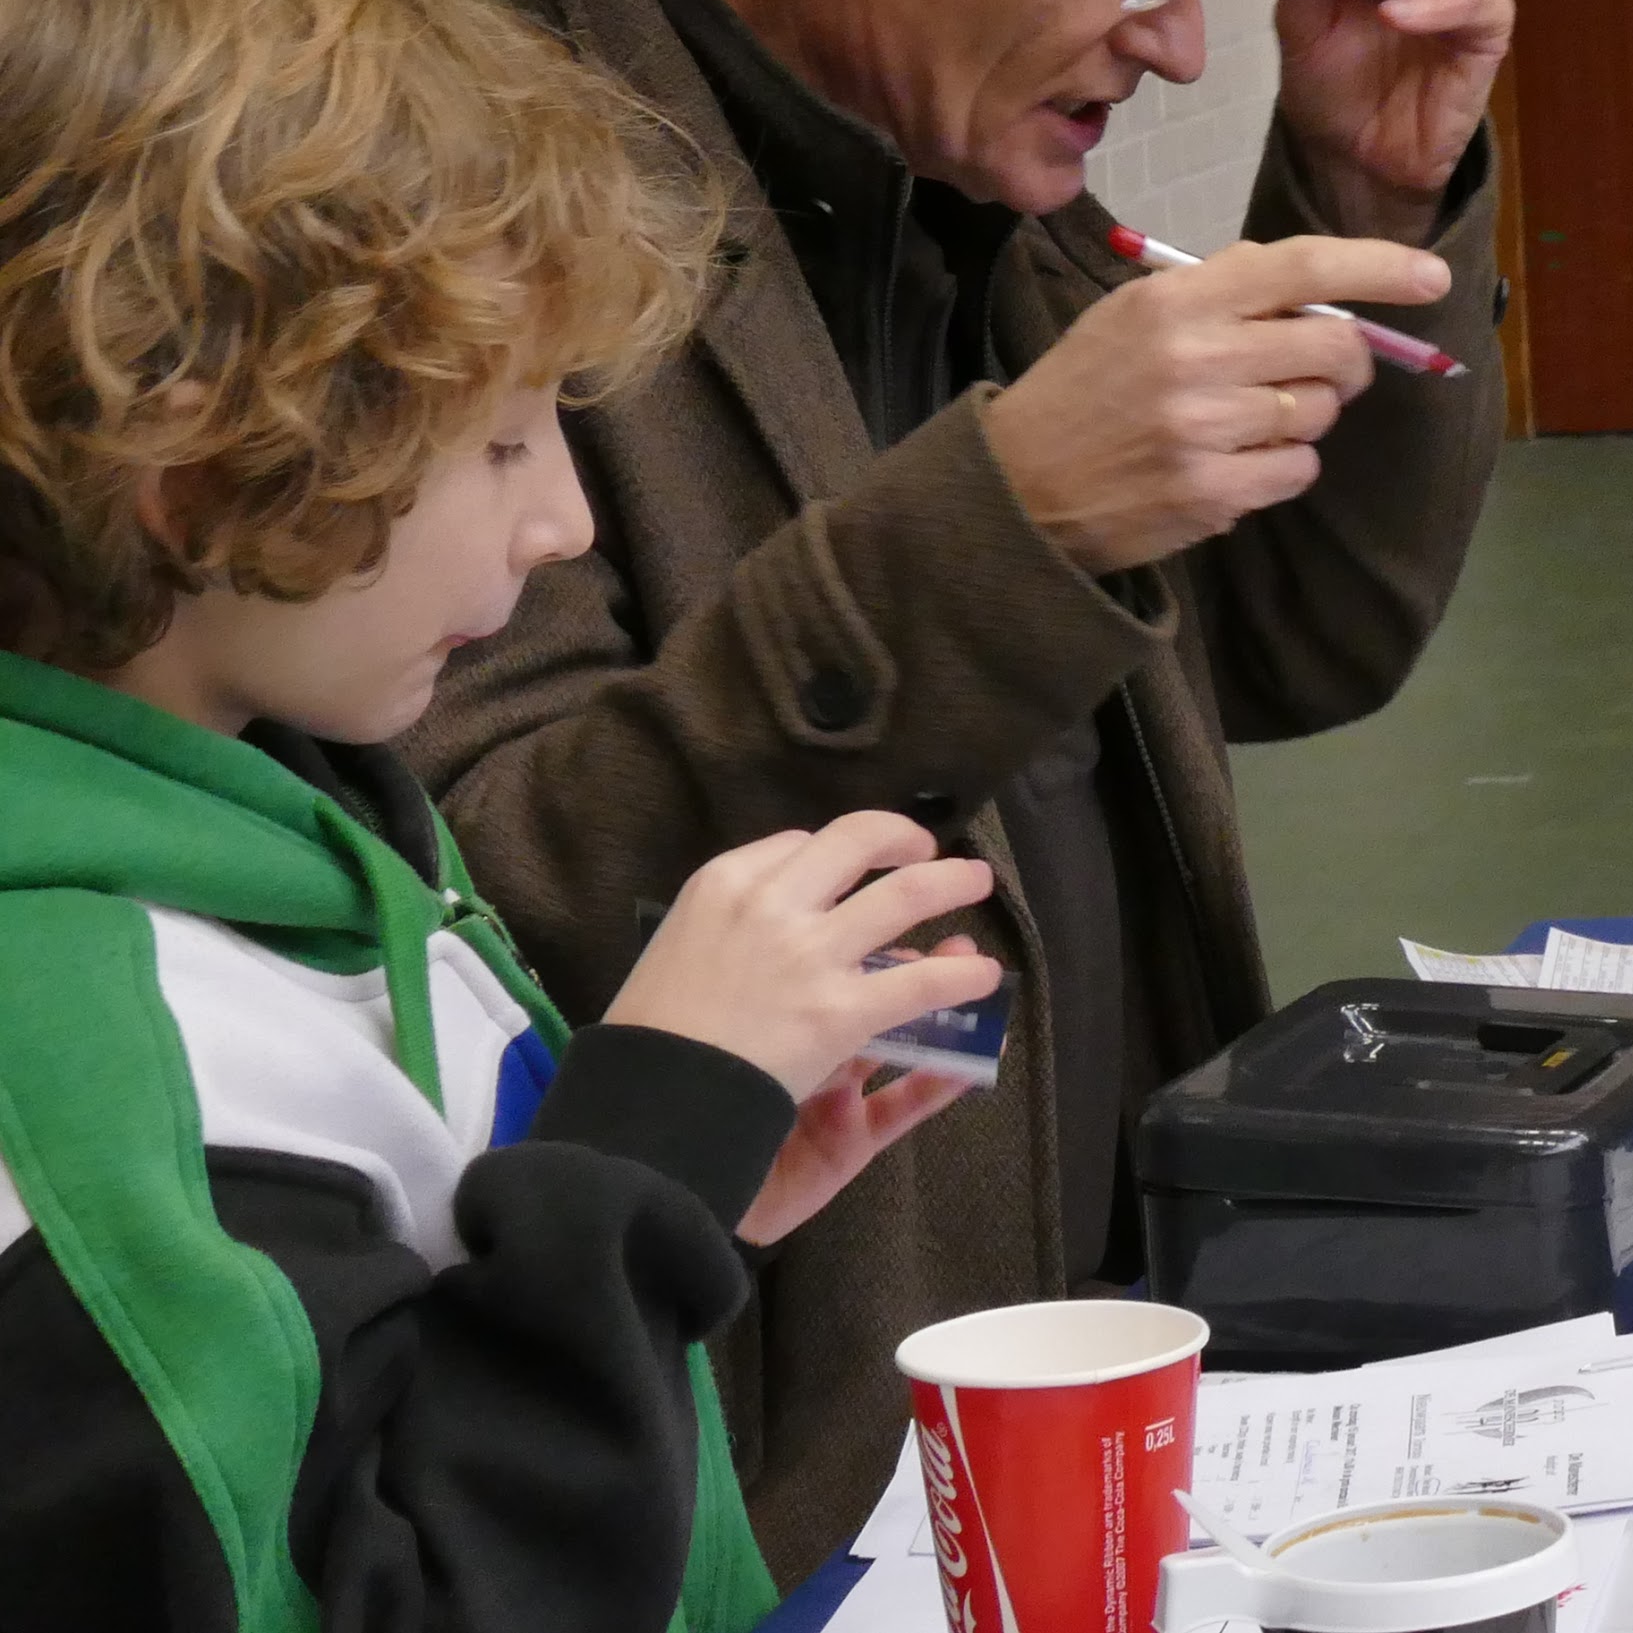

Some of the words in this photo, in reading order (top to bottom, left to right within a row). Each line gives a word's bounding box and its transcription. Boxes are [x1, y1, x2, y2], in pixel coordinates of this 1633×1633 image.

[1101, 1437, 1112, 1448] of
[1114, 1431, 1125, 1480] Company
[1145, 1424, 1175, 1452] 0,25L
[1102, 1448, 1113, 1511] trademarks
[1104, 1512, 1113, 1529] are
[1114, 1481, 1125, 1534] Coca-Cola
[1103, 1531, 1114, 1568] Ribbon
[1115, 1535, 1125, 1555] The
[1104, 1568, 1117, 1615] Dynamic
